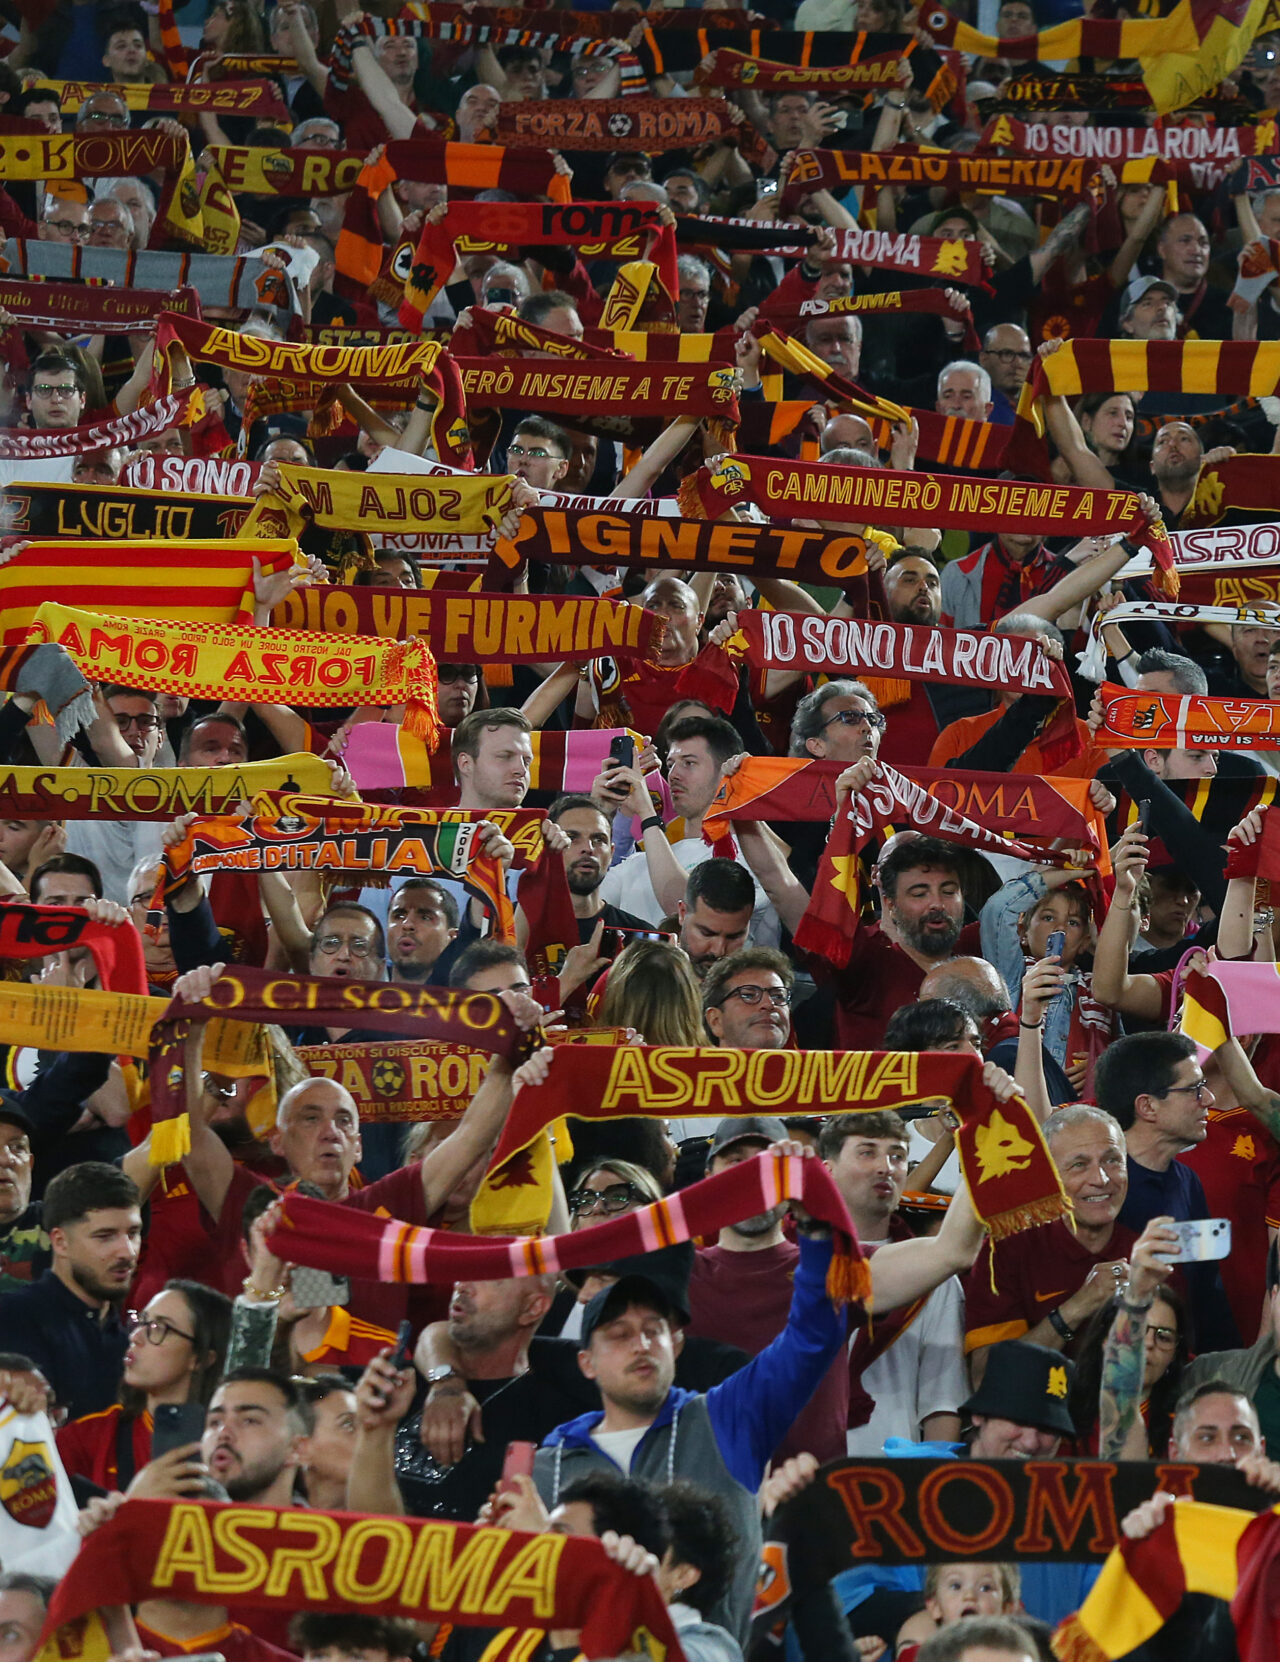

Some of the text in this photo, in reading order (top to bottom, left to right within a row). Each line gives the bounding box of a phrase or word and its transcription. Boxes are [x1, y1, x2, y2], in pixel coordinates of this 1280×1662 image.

[516, 111, 722, 138] FORZA ROMA
[1024, 123, 1241, 159] IO SONO LA ROMA
[834, 151, 1086, 193] LAZIO MERDA
[842, 227, 921, 268] ROMA
[200, 327, 441, 378] ASROMA
[521, 372, 696, 401] INSIEME A TE
[126, 457, 254, 498] IO SONO
[766, 469, 1140, 521] CAMMINERÒ INSIEME A TE
[58, 498, 194, 540] LUGLIO
[493, 510, 868, 578] PIGNETO
[444, 599, 647, 656] FURMINI
[761, 612, 1055, 690] IO SONO LA ROMA
[1191, 733, 1231, 745] AMA
[1236, 734, 1253, 746] SI
[88, 773, 249, 814] ROMA
[193, 838, 435, 875] CAMPIONE D'ITALIA
[262, 980, 320, 1010] CI
[334, 1048, 367, 1060] NON
[369, 1047, 384, 1058] SI
[600, 1046, 919, 1109] ASROMA
[151, 1504, 567, 1619] ASROMA
